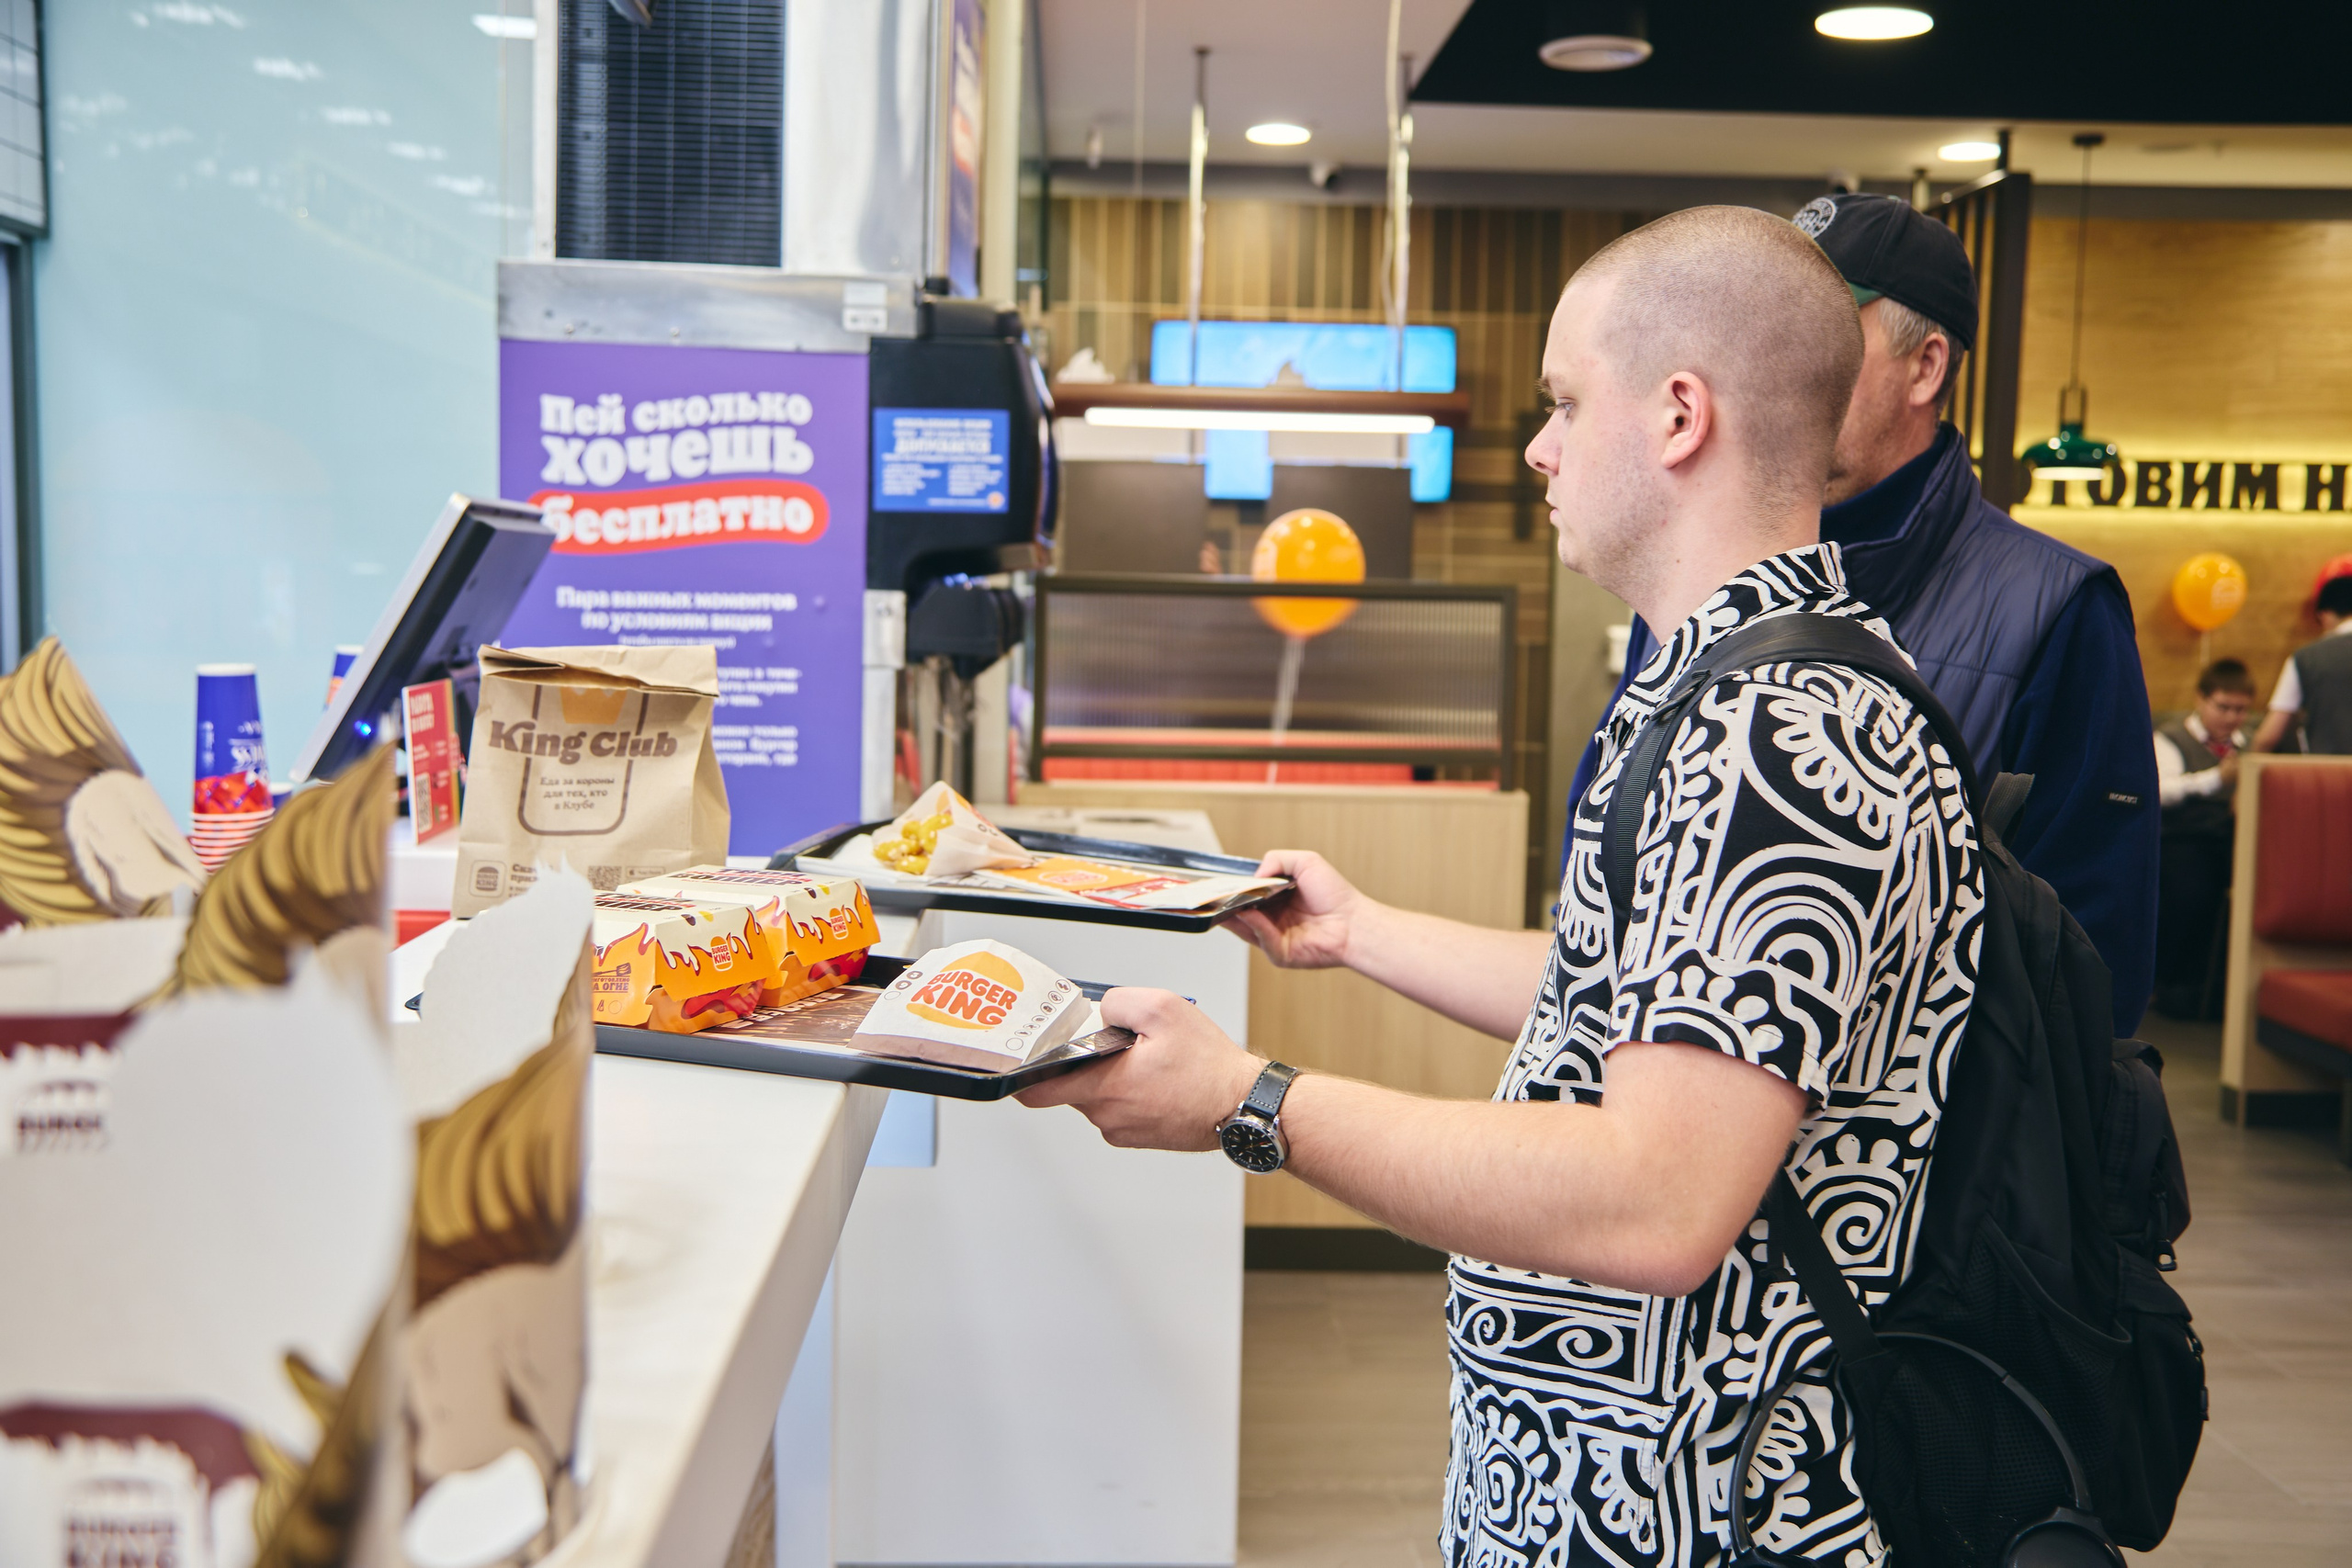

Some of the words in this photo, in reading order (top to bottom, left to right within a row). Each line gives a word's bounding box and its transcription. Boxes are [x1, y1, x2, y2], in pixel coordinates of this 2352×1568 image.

[539, 393, 626, 435] Пей
[632, 391, 813, 433] сколько
[540, 425, 815, 487] хочешь
[540, 494, 815, 545] бесплатно
[489, 720, 586, 765] King
[590, 730, 678, 758] Club
[540, 777, 560, 786] Еда
[563, 778, 575, 786] за
[576, 778, 616, 787] короны
[543, 790, 563, 798] для
[567, 790, 587, 799] тех,
[590, 789, 608, 797] кто
[563, 800, 595, 811] Клубе
[668, 873, 803, 886] ВОППЕР
[832, 921, 846, 932] KING
[711, 944, 729, 954] BURGER
[714, 952, 731, 964] KING
[603, 982, 629, 991] ОГНЕ
[929, 971, 1017, 1010] BURGER
[910, 985, 1007, 1026] KING
